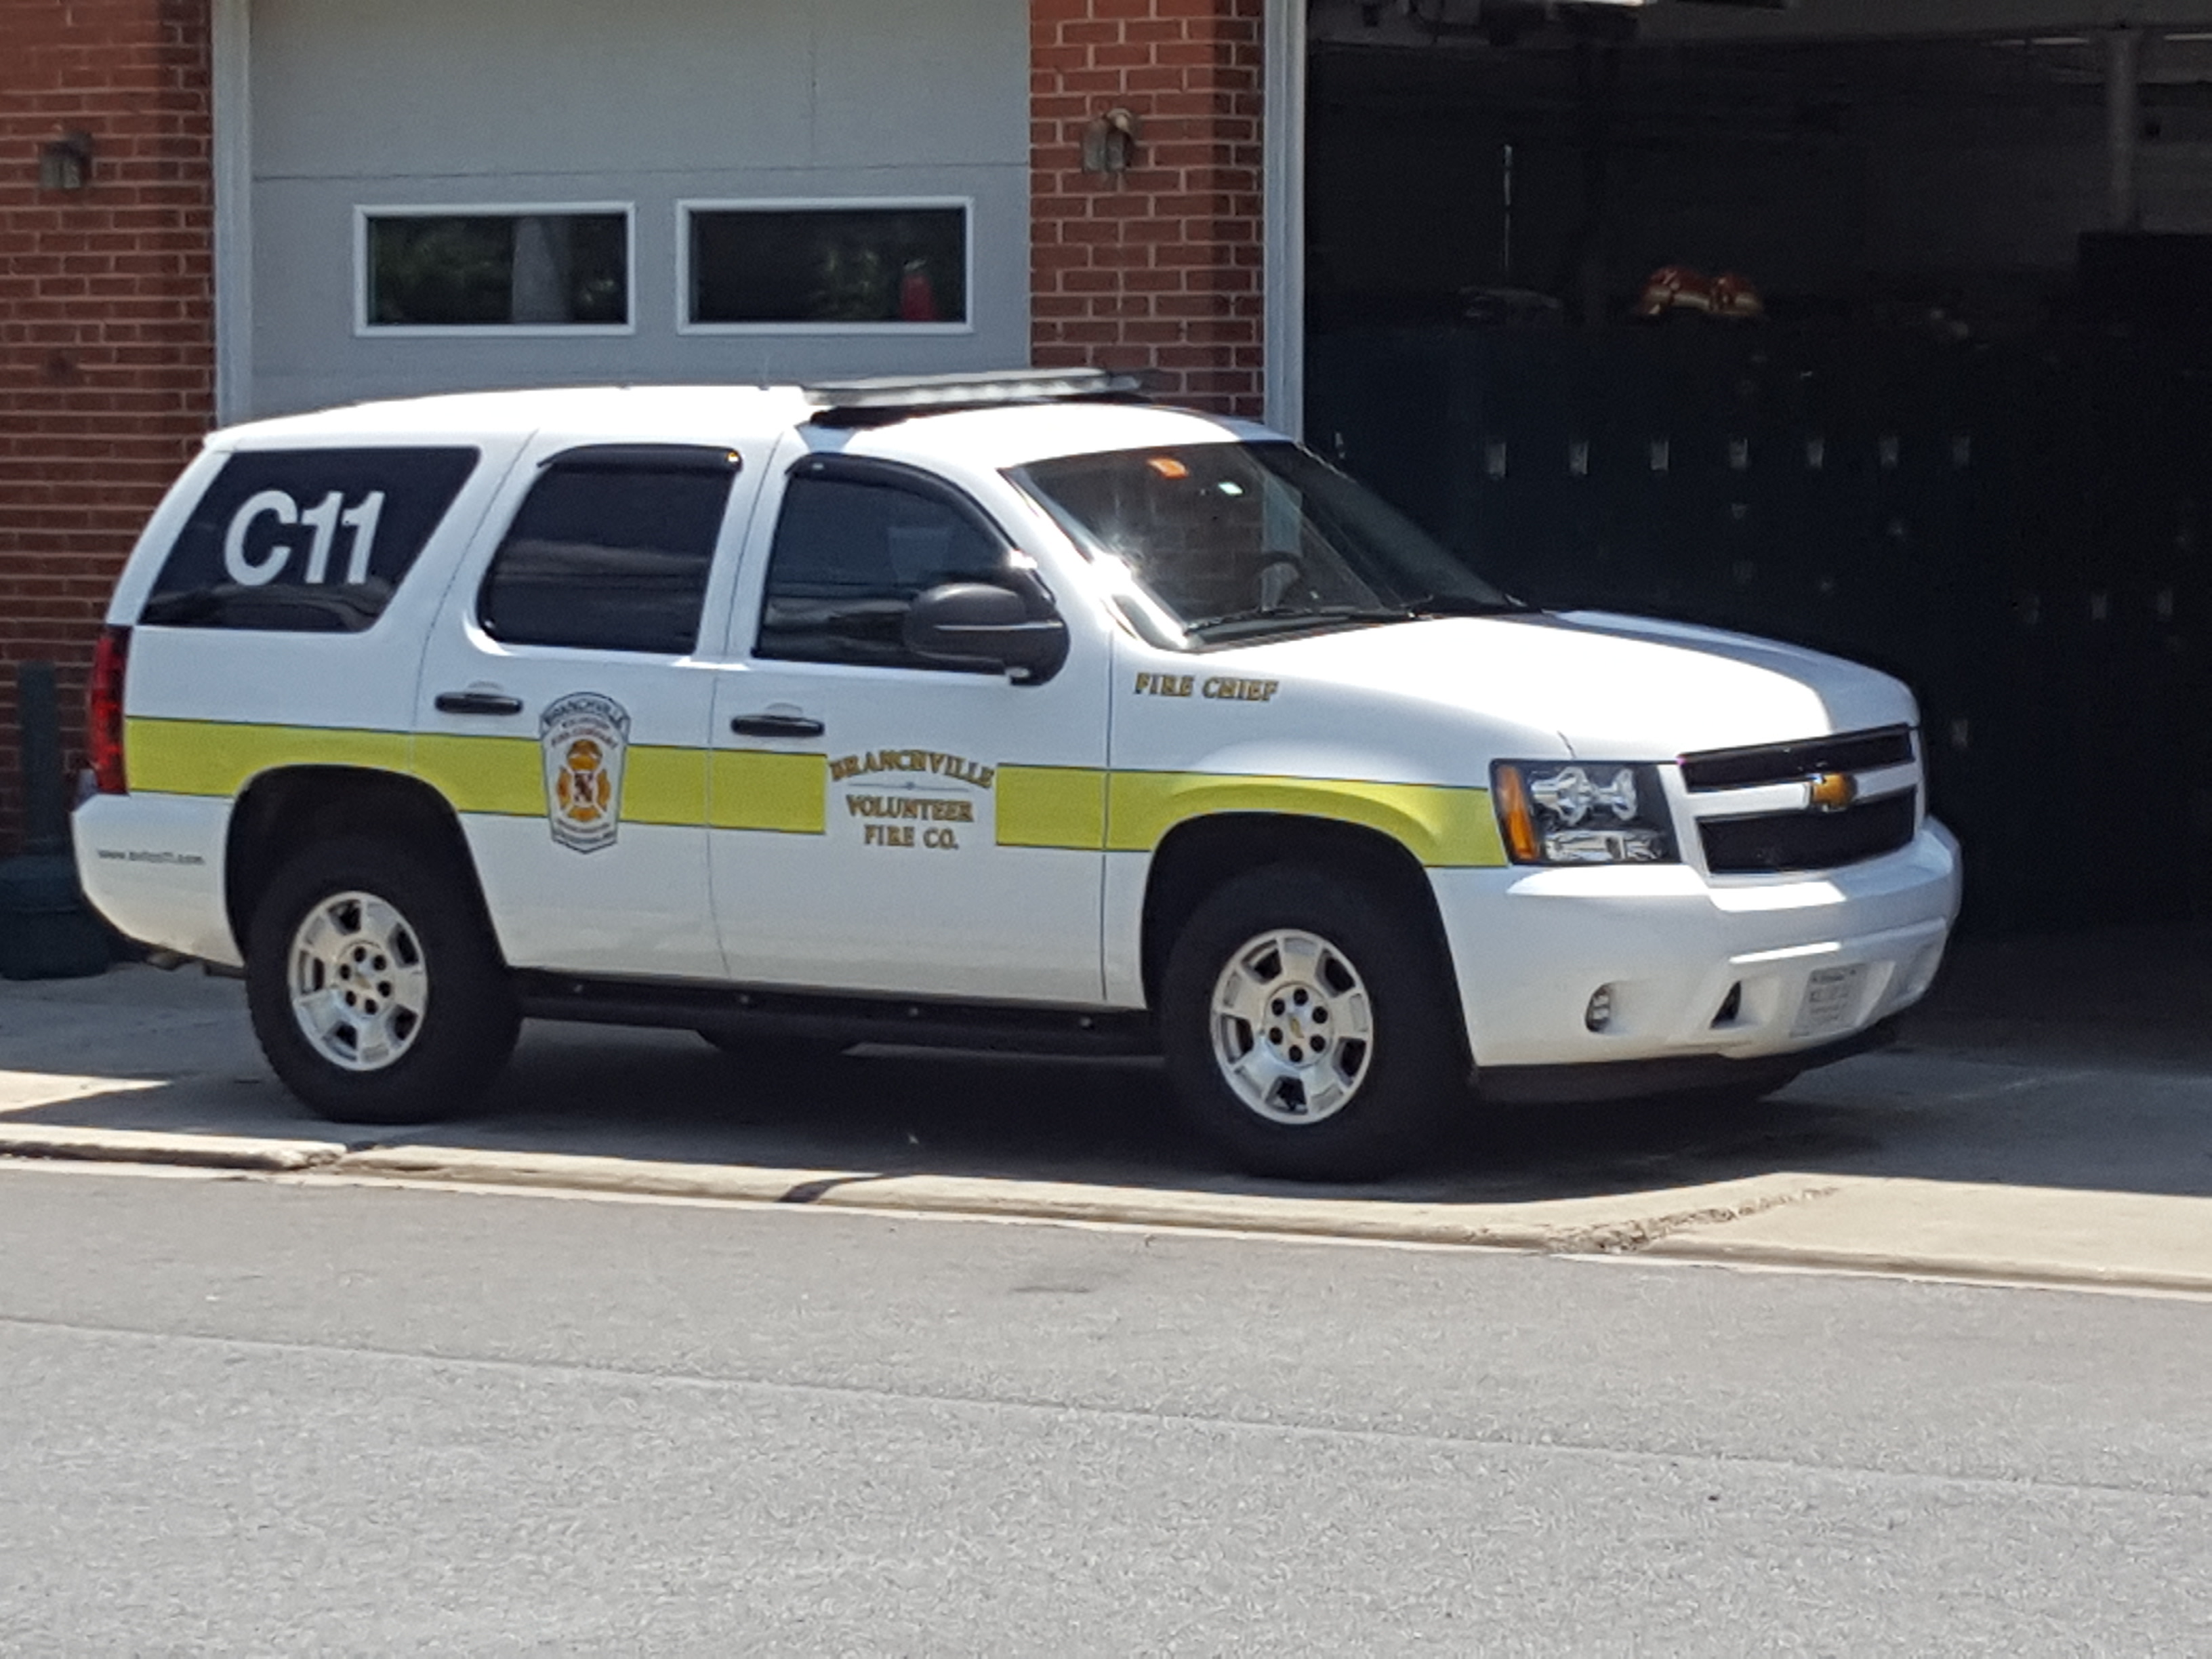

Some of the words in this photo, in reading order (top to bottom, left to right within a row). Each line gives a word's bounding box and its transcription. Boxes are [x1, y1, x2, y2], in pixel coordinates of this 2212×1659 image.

[224, 489, 385, 586] C11
[1134, 672, 1195, 697] FIRE
[1202, 676, 1279, 701] CHIEF
[830, 750, 995, 789] BRANCHVILLE
[846, 794, 975, 822] VOLUNTEER
[864, 824, 915, 846] FIRE
[923, 827, 960, 850] CO.
